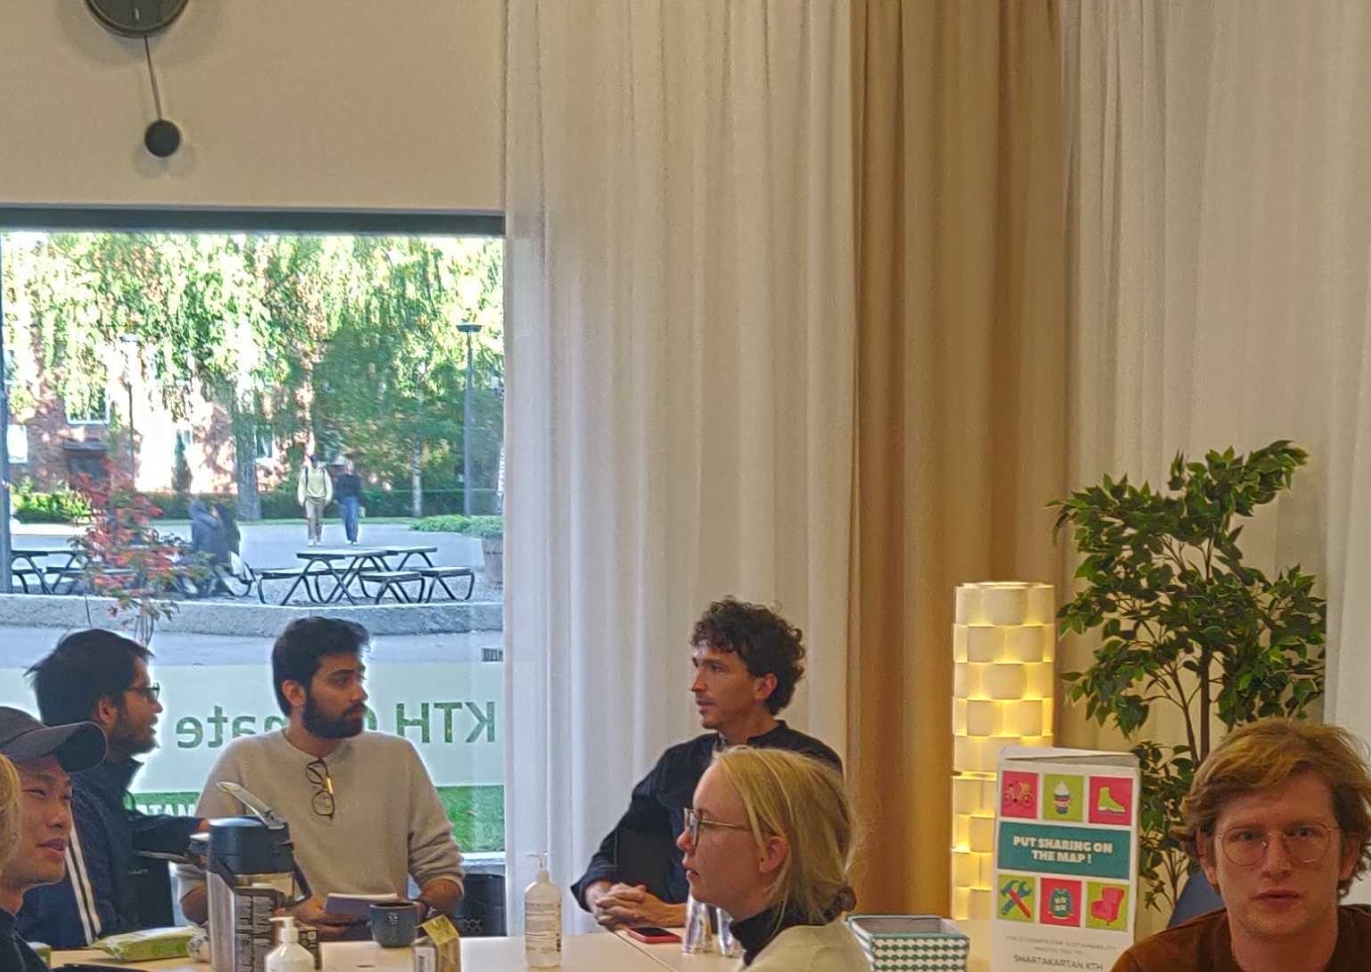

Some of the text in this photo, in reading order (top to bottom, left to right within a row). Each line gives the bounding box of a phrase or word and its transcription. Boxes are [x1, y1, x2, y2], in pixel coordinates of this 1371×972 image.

[1012, 834, 1114, 855] PUT SHARING ON
[1031, 849, 1056, 863] THE
[1056, 851, 1086, 864] MAP
[1085, 961, 1104, 971] KTH
